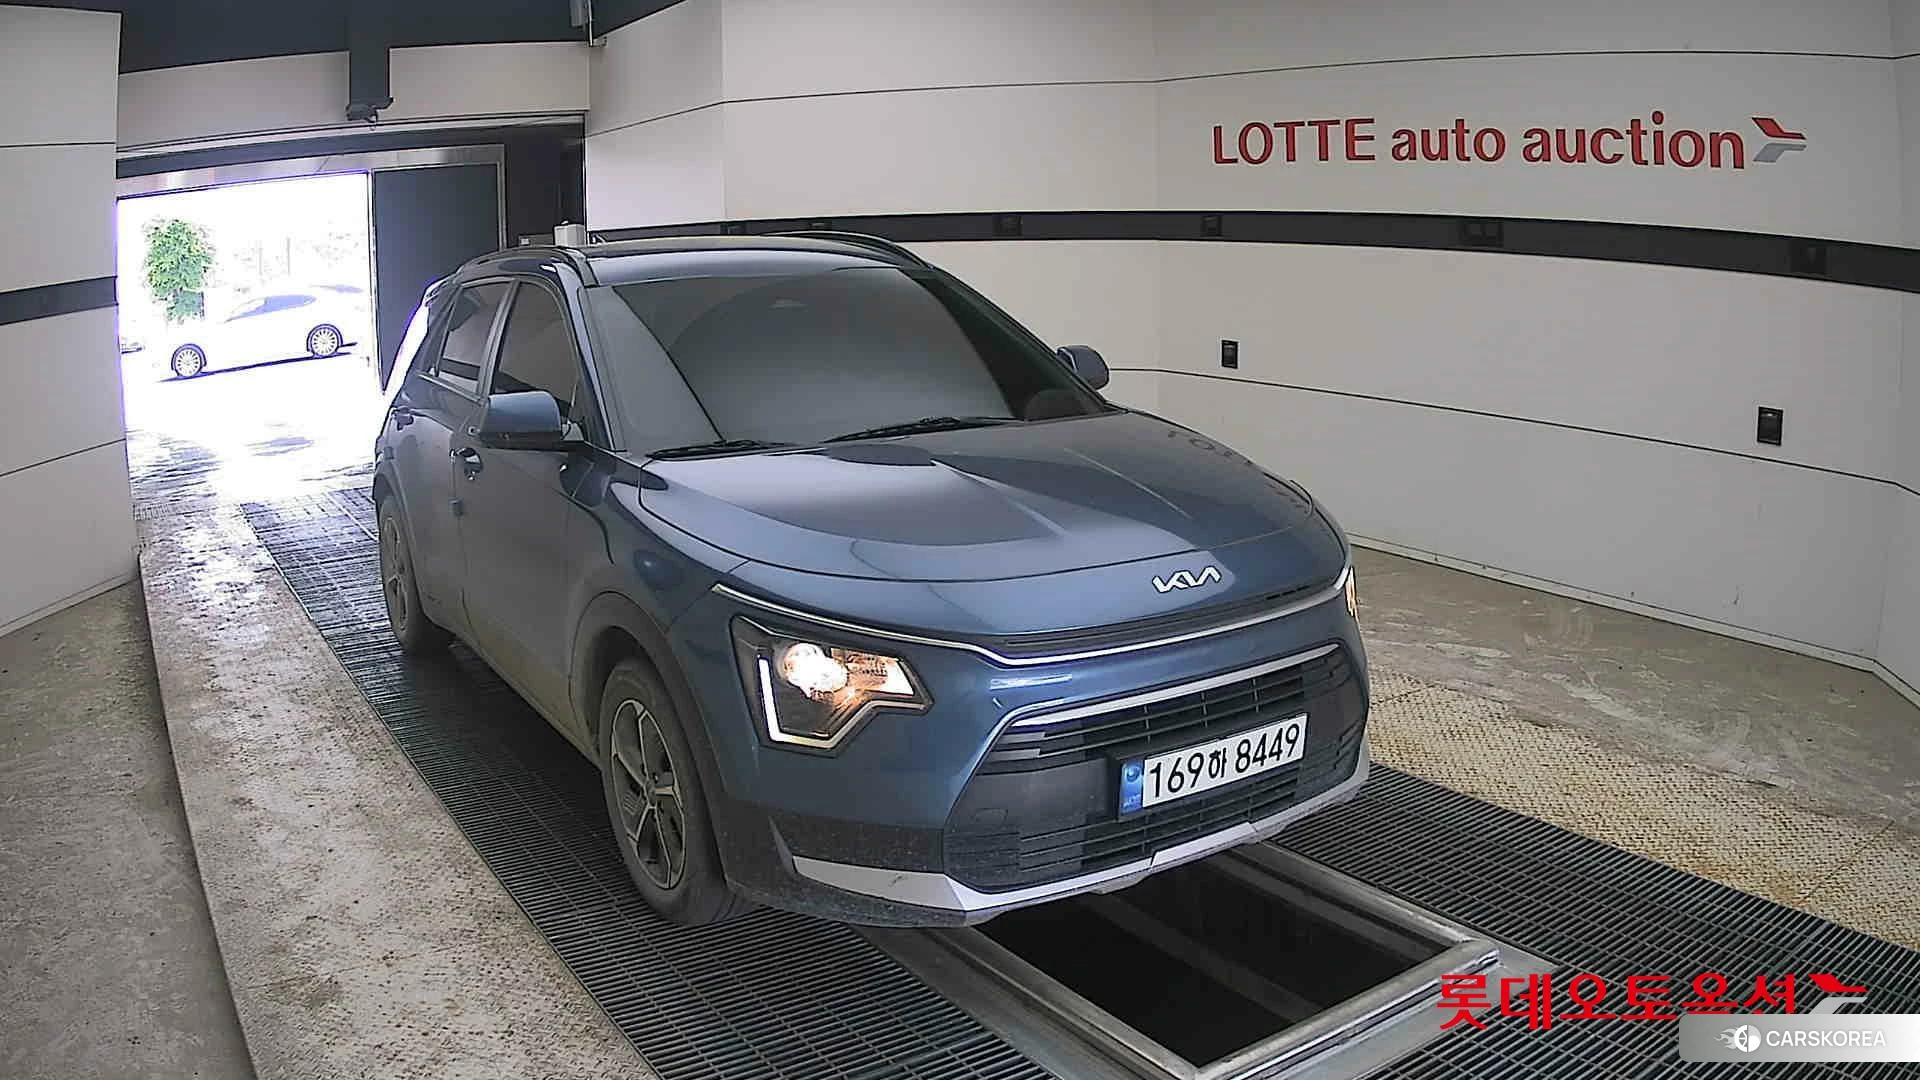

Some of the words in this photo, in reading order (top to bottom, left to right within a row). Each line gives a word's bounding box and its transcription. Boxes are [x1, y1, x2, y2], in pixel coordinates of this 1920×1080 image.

[1213, 118, 1376, 165] LOTTE
[1391, 118, 1507, 162] auto
[1522, 110, 1745, 169] auction
[1150, 748, 1227, 798] 169하
[1235, 723, 1300, 774] 8449
